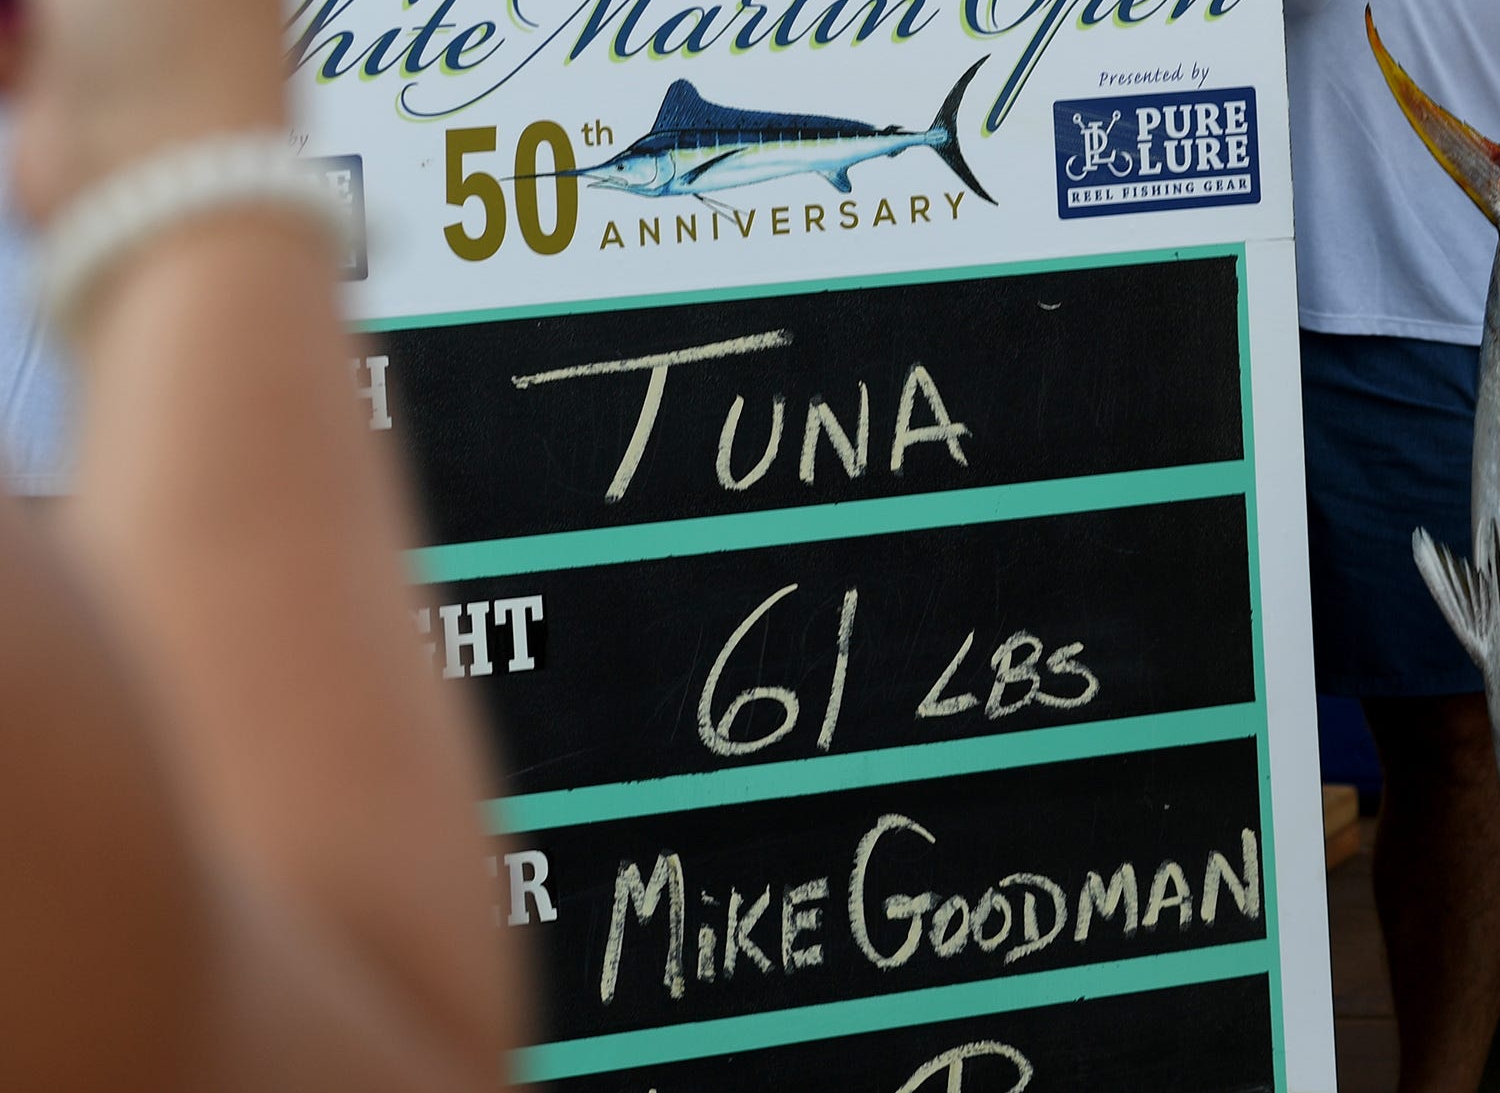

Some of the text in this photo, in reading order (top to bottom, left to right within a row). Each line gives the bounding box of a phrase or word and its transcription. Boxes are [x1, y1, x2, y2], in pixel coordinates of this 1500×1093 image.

[1099, 61, 1210, 88] Presented by
[1136, 100, 1249, 142] PURE
[1137, 134, 1250, 176] LURE
[1071, 177, 1248, 203] REEL FISHING GEAR
[600, 191, 966, 250] ANNIVERSARY
[511, 328, 973, 504] TUNA
[697, 582, 1100, 757] 61 LBS
[847, 813, 1261, 971] GOODMAN
